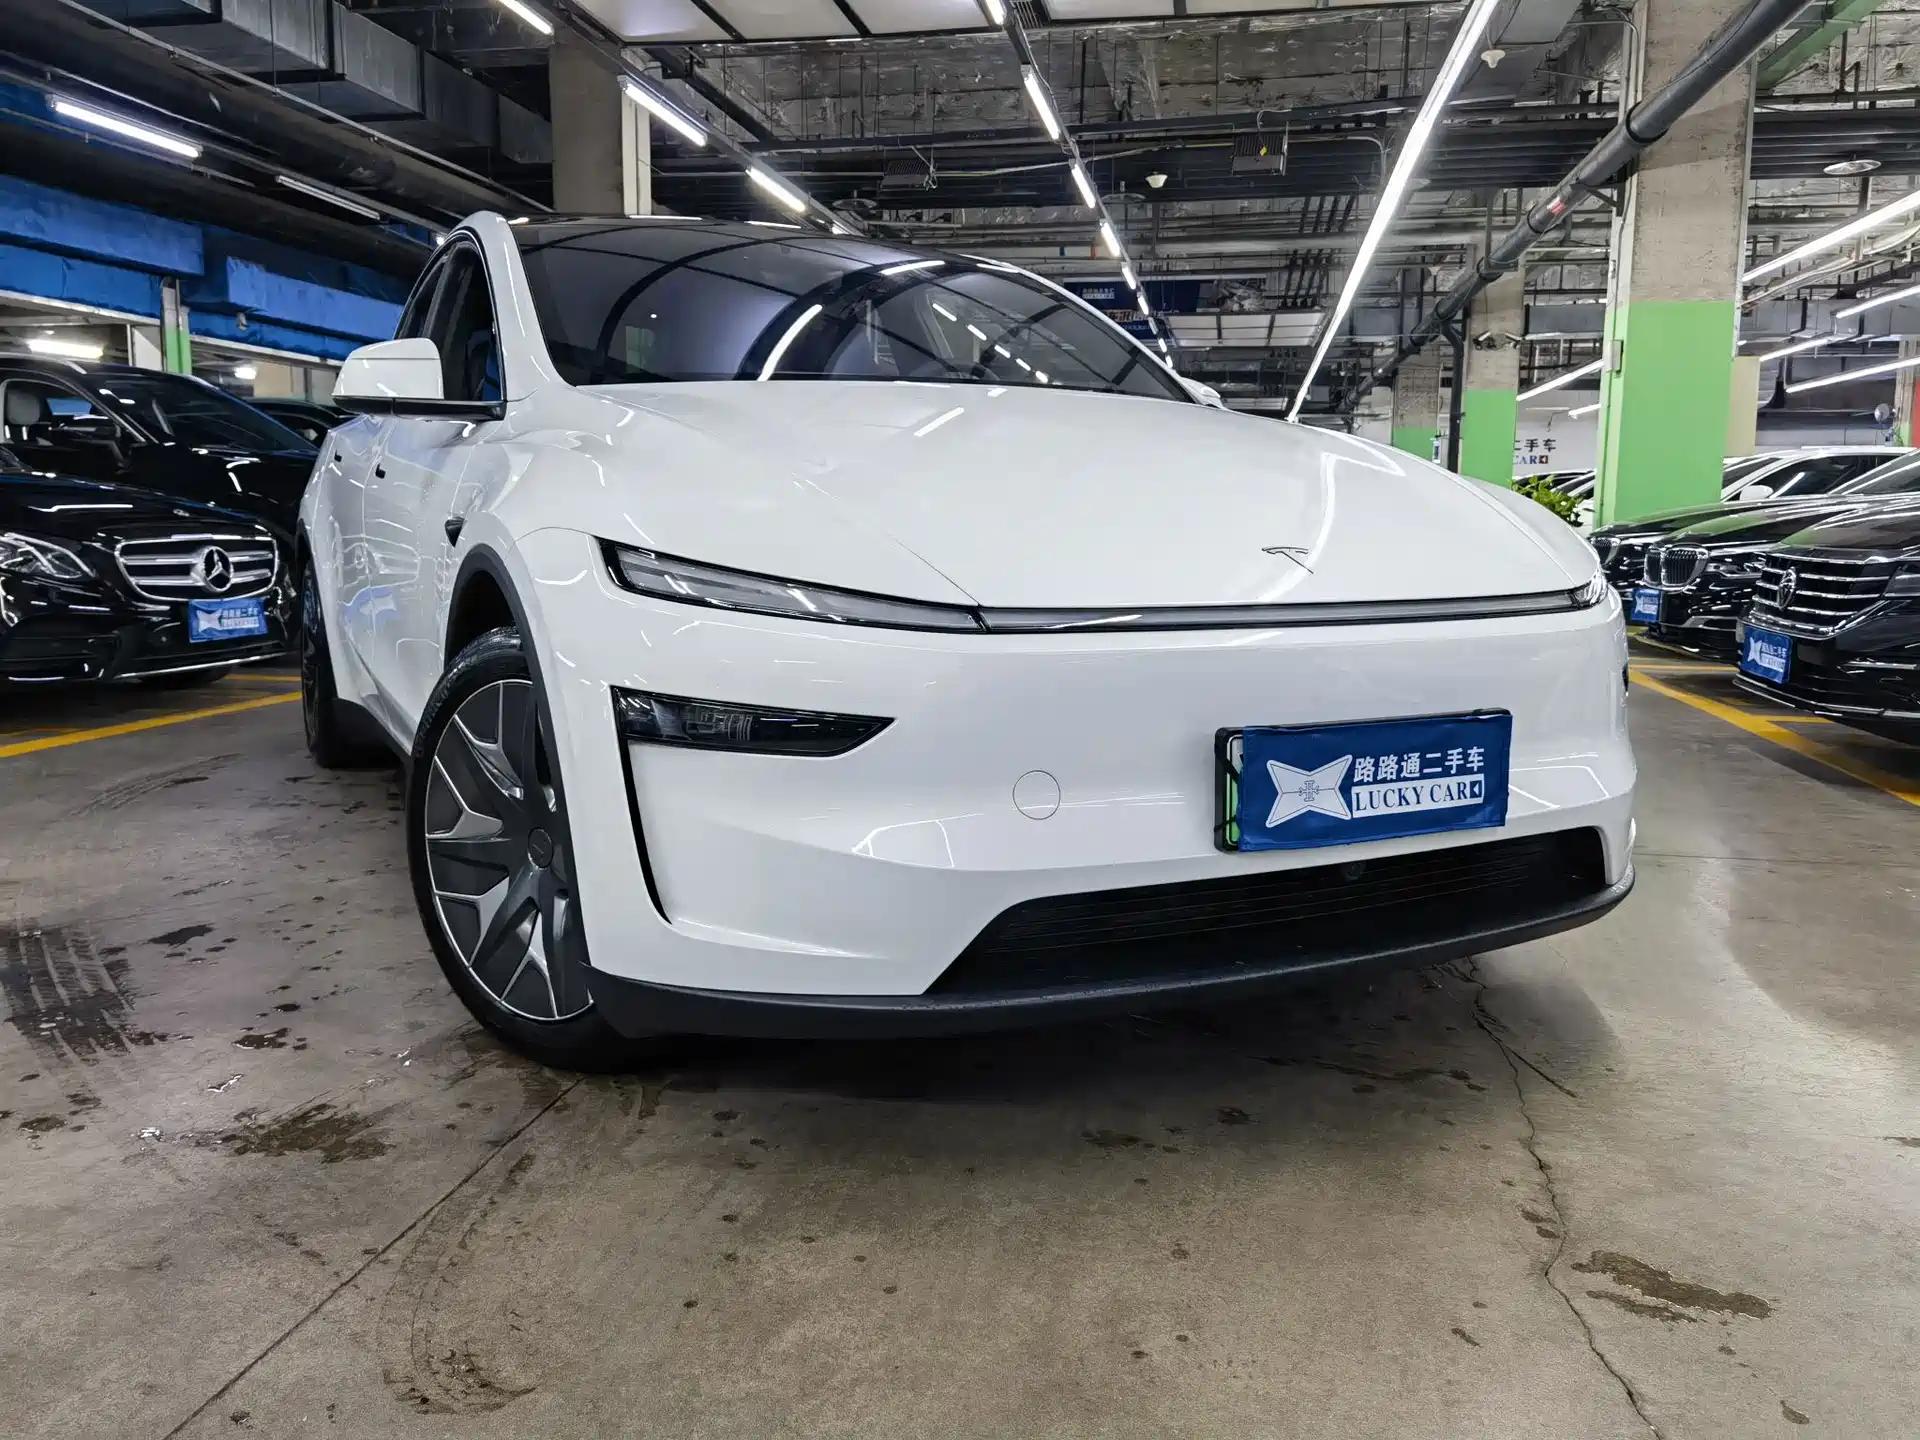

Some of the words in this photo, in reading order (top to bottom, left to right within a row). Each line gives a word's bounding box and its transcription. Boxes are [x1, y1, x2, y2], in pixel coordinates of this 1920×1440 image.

[1514, 438, 1557, 453] 二手车
[1353, 746, 1485, 783] 路路通二手车
[1355, 785, 1424, 812] LUCKY
[1429, 781, 1468, 804] CAR
